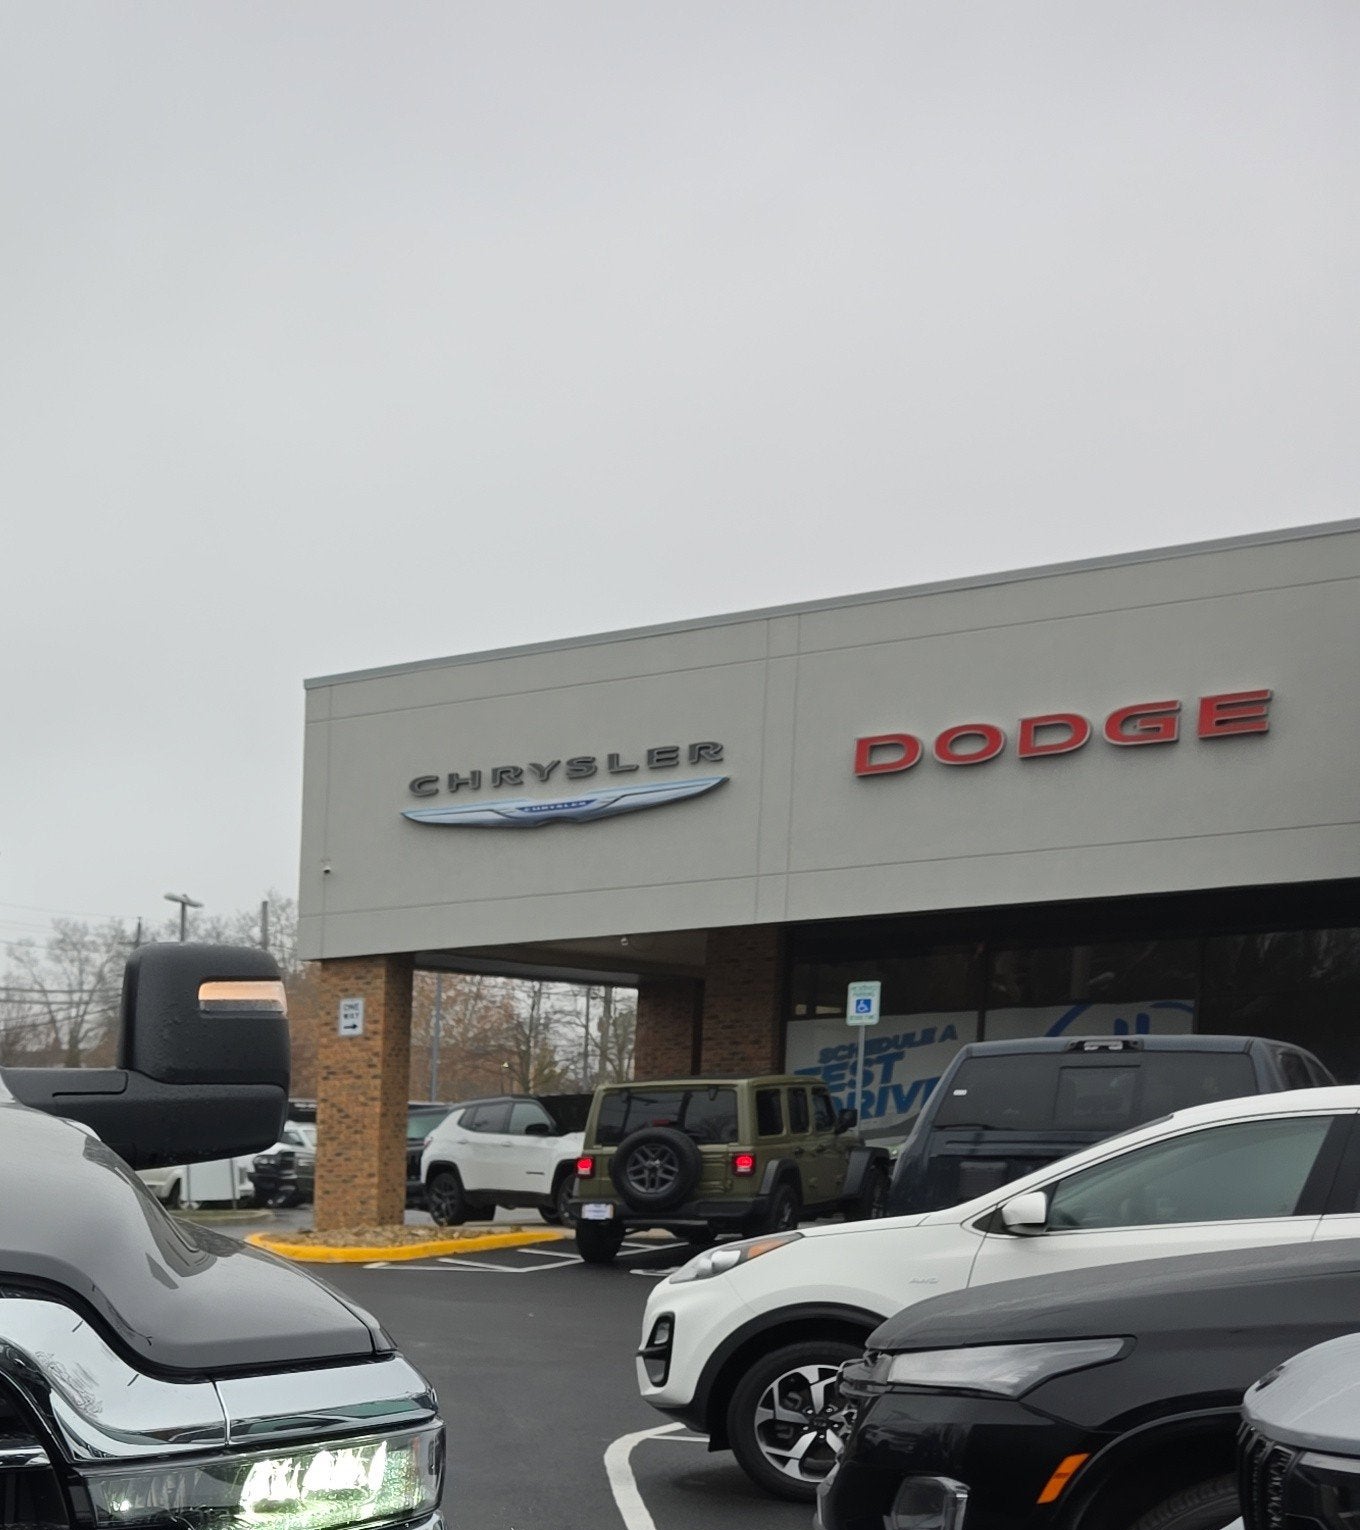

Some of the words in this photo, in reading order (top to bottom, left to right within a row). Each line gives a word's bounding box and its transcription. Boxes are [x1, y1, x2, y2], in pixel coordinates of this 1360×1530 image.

[854, 688, 1273, 777] DODGE
[408, 741, 725, 798] CHRYSLER
[938, 1023, 959, 1043] A
